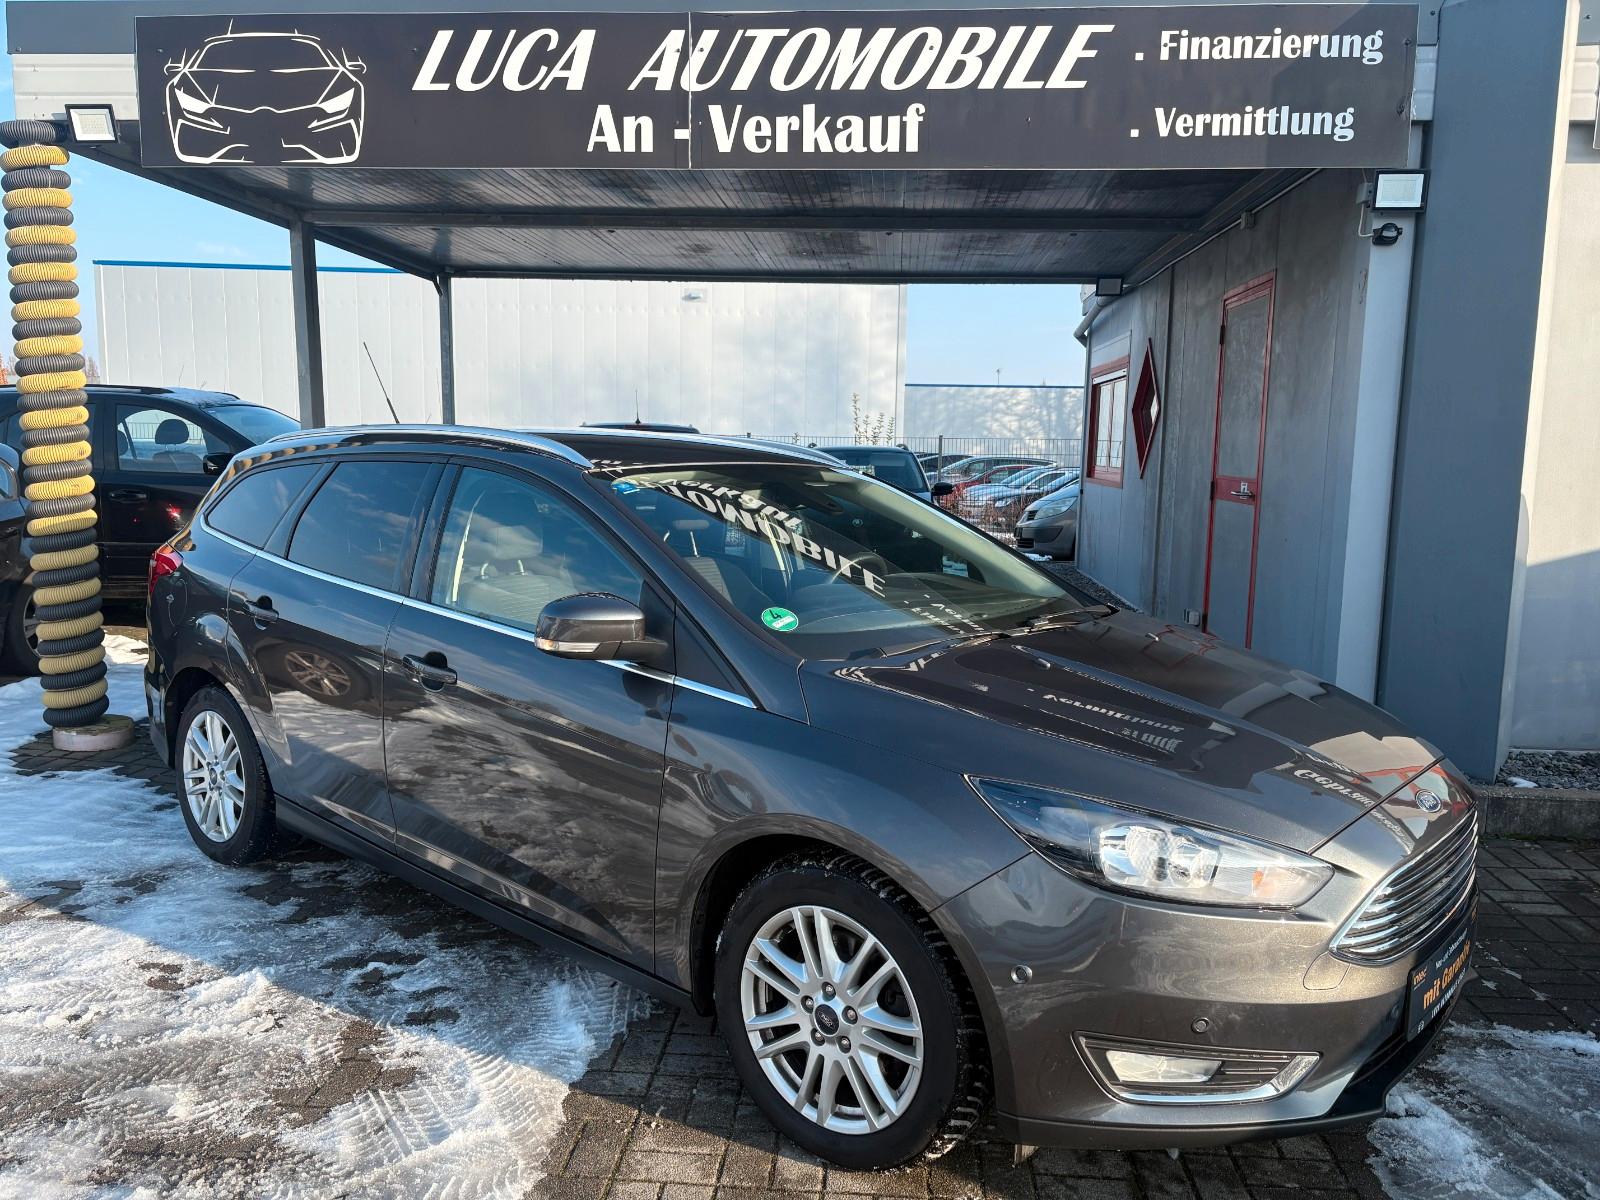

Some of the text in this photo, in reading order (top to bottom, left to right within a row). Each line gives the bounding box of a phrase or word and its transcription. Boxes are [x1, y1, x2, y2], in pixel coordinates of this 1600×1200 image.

[411, 24, 1115, 92] LUCA AUTOMOBILE
[1159, 27, 1384, 65] Finanzierung
[587, 104, 654, 152] An
[708, 102, 925, 153] Verkauf
[1155, 105, 1355, 142] Vermittlung
[1423, 977, 1441, 1010] mit
